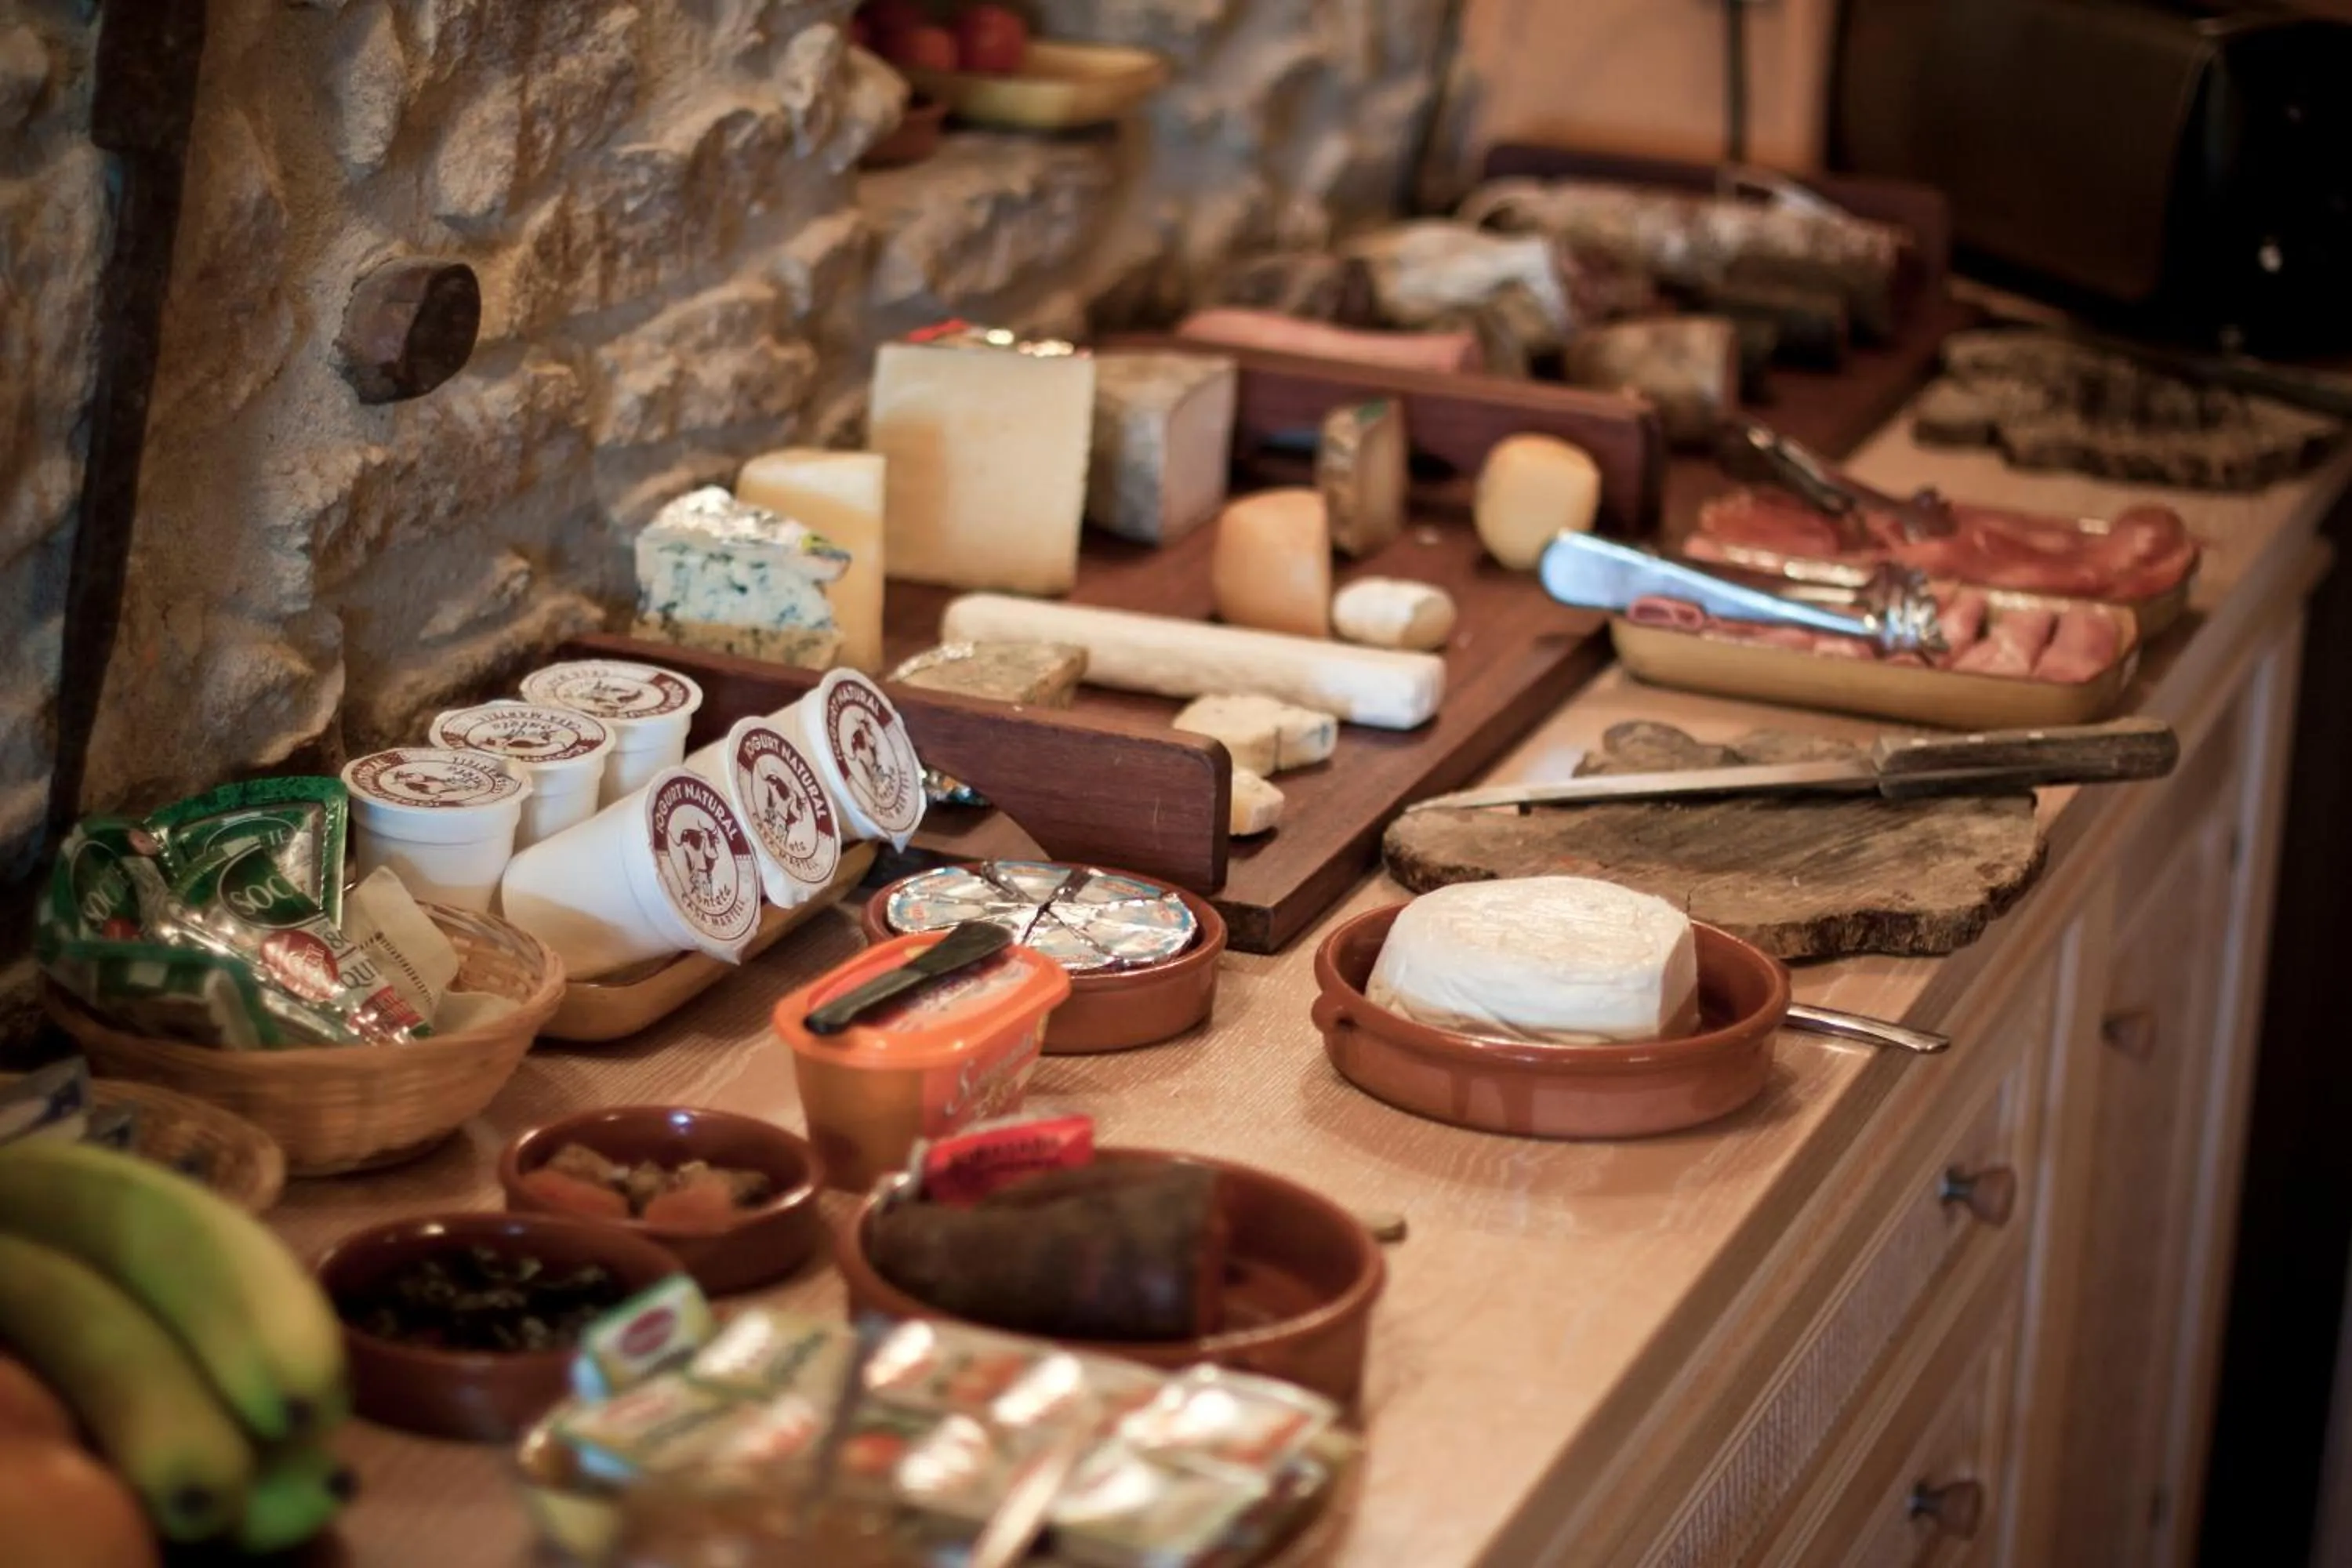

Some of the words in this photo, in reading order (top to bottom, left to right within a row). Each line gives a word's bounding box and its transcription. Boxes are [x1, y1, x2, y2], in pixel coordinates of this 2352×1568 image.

[838, 684, 881, 715] NATURAL
[745, 732, 780, 760] IOGURT
[781, 745, 828, 818] NATURAL
[655, 783, 683, 834] IOGURT
[684, 782, 739, 841] NATURAL
[229, 875, 293, 916] SOC
